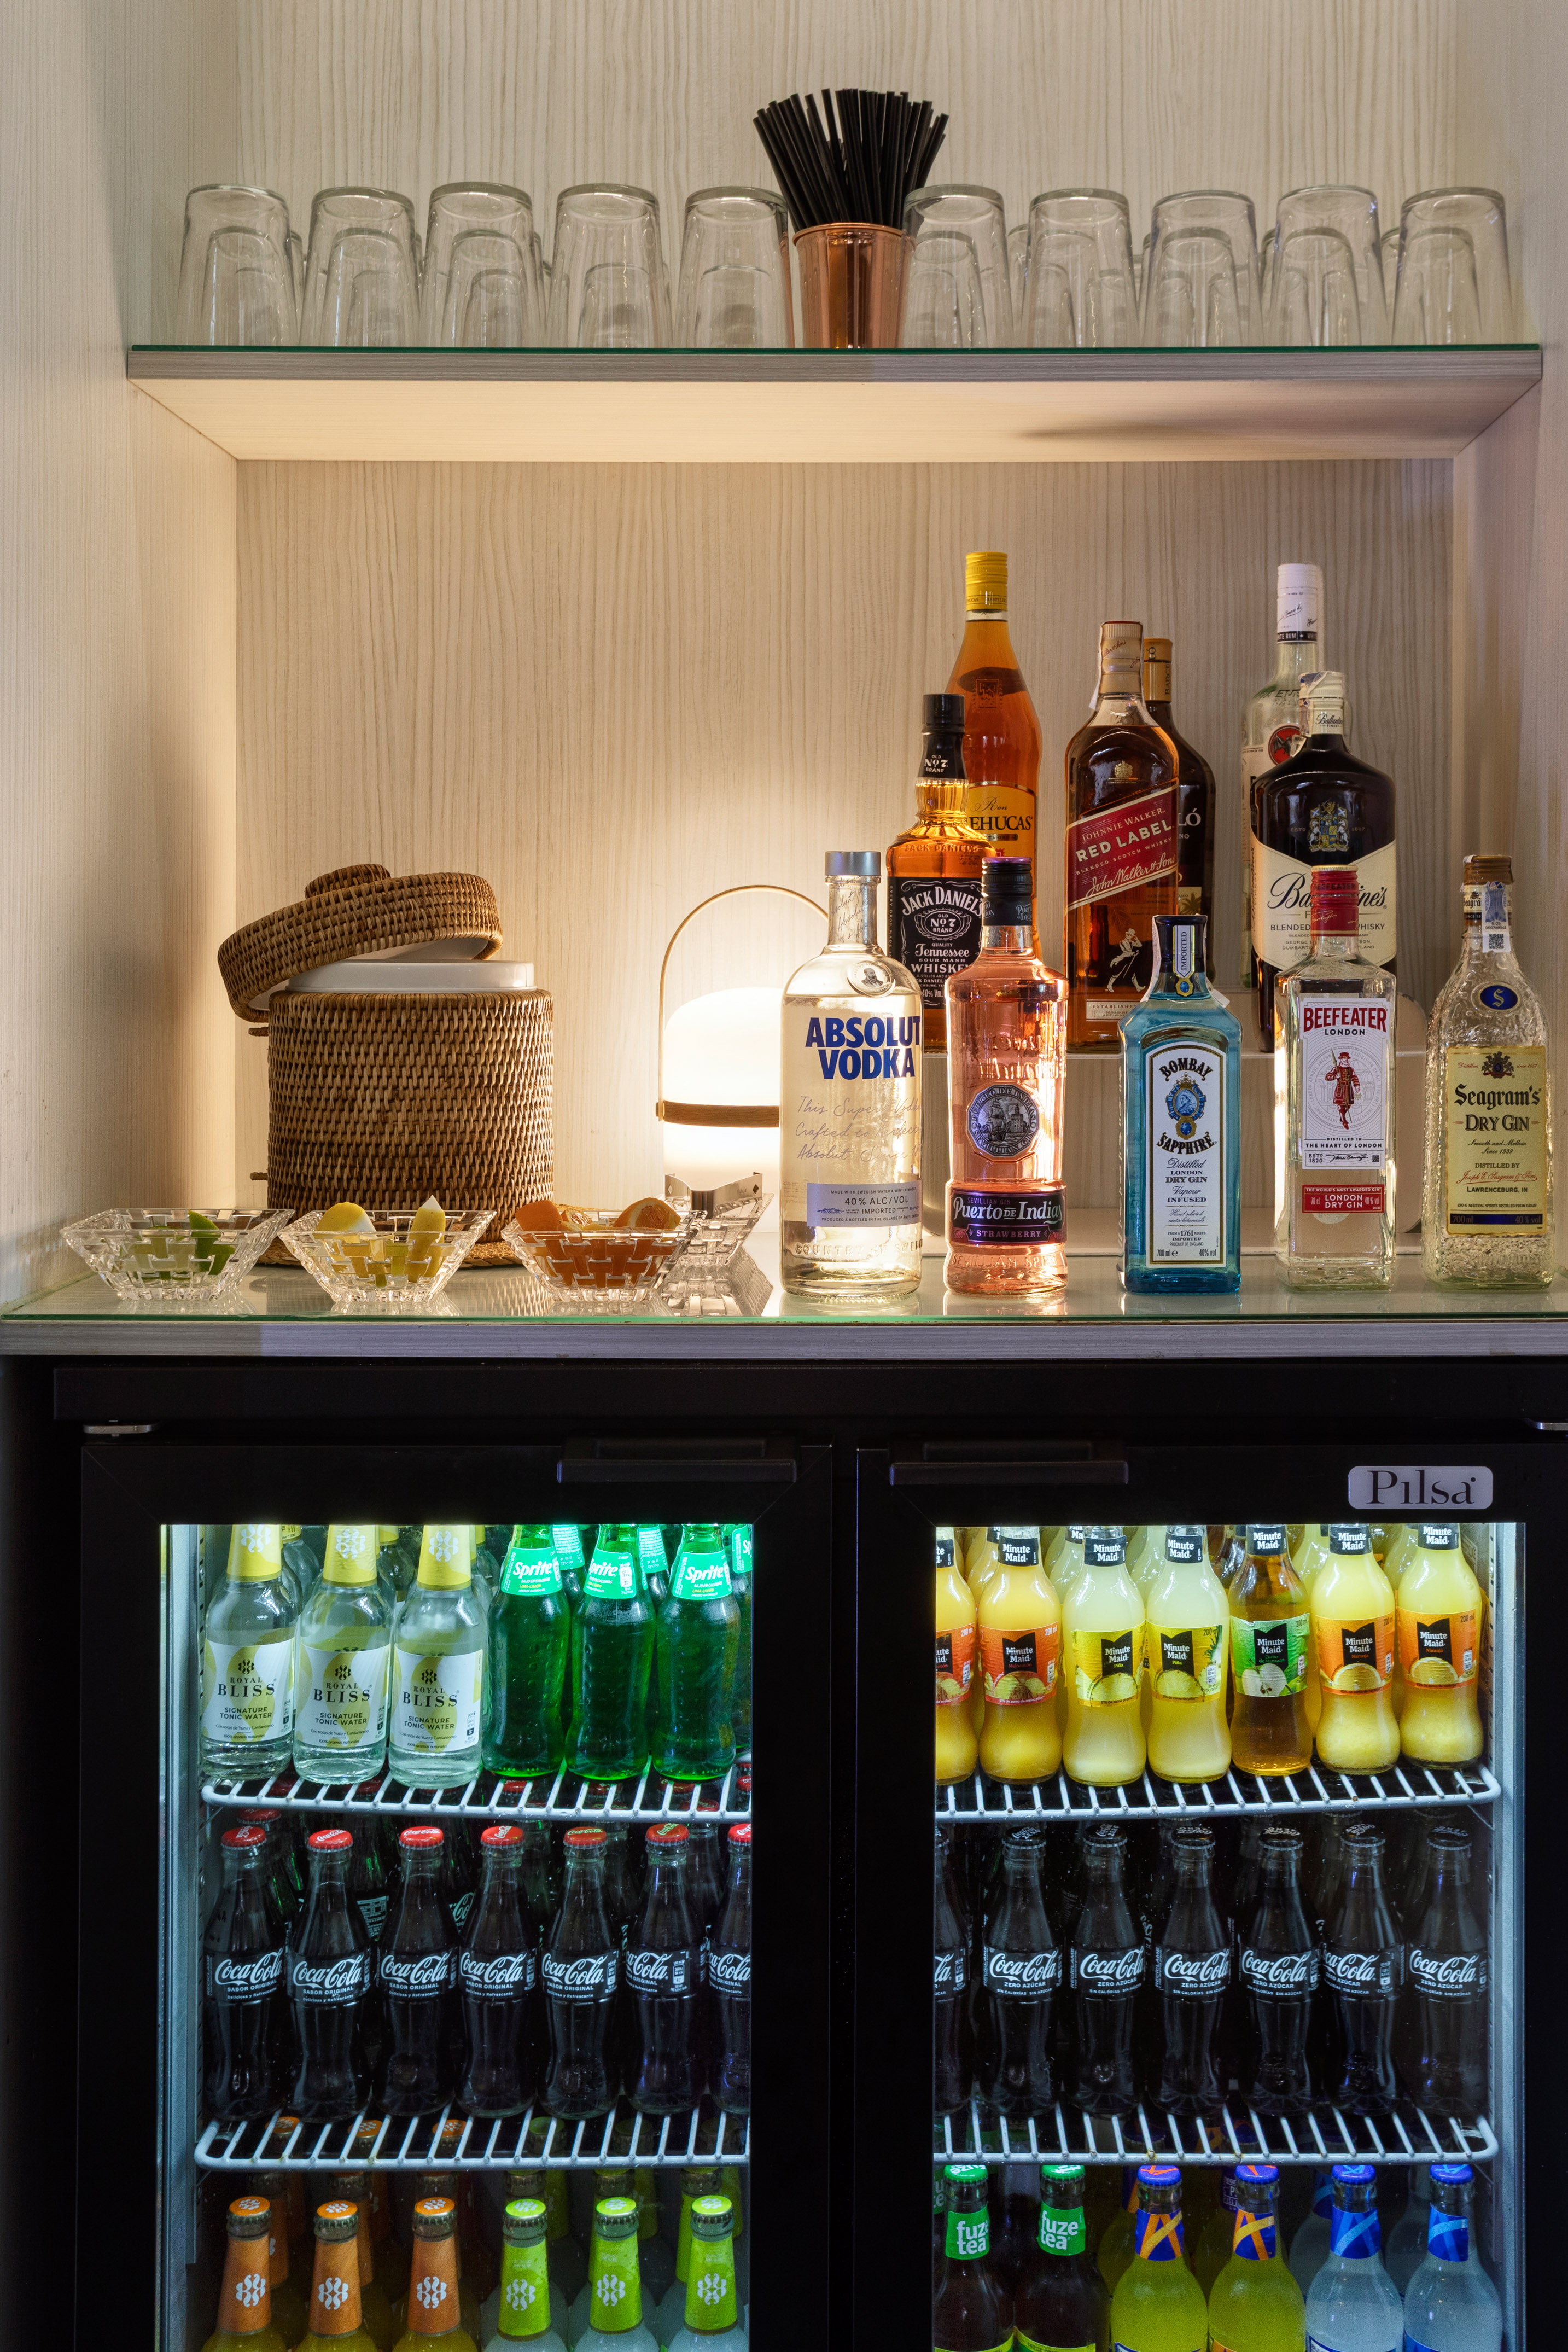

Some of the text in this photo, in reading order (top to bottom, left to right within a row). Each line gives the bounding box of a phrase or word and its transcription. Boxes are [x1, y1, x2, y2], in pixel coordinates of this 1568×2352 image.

[971, 796, 1007, 812] Ron
[967, 816, 1031, 830] EHUCAS
[1081, 822, 1123, 844] JOHNNIE
[1124, 808, 1163, 826] WALKER
[1076, 819, 1171, 863] RED LABEL
[1076, 837, 1172, 875] BLENDED SCOTCH WHISKY
[901, 888, 934, 916] JACK
[934, 886, 984, 916] DANIEL'S
[915, 944, 970, 957] Tennessee
[1303, 1007, 1386, 1033] BEEFEATER
[805, 1015, 921, 1049] ABSOLUT
[818, 1047, 916, 1080] VODKA
[1159, 1057, 1213, 1082] BOMBAY
[1454, 1083, 1540, 1110] Seagram's
[972, 1089, 995, 1121] PUERTO
[1015, 1090, 1036, 1121] INDIAS
[1465, 1114, 1530, 1131] DRY GIN
[974, 1130, 1035, 1156] SEVILLIAN GIN
[1156, 1132, 1215, 1155] SAPPHIRE
[1166, 1158, 1205, 1169] Distilled
[1172, 1186, 1202, 1195] Vapour
[953, 1196, 1063, 1224] Puerto DE Indias
[976, 1230, 1041, 1238] STRAWBERRY
[1253, 1532, 1281, 1541] Minute
[1338, 1532, 1366, 1541] Minute
[1423, 1526, 1452, 1536] Minute
[1168, 1538, 1194, 1550] Minute
[1256, 1540, 1280, 1550] Maid
[1342, 1541, 1365, 1550] Maid
[1426, 1535, 1449, 1545] Maid
[1002, 1543, 1030, 1553] Minute
[1094, 1544, 1121, 1553] Minute
[1169, 1548, 1191, 1559] Maid
[1005, 1553, 1028, 1563] Maid
[1097, 1553, 1119, 1562] Maid
[513, 1561, 552, 1579] Sprite
[685, 1565, 724, 1583] Sprite
[1345, 1637, 1373, 1646] Minute
[1420, 1631, 1448, 1640] Minute
[1163, 1643, 1190, 1652] Minute
[1349, 1644, 1371, 1653] Maid
[1424, 1639, 1445, 1647] Maid
[1005, 1647, 1033, 1655] Minute
[1105, 1646, 1131, 1656] Minute
[1167, 1651, 1187, 1660] Maid
[1261, 1645, 1283, 1654] Maid
[1010, 1655, 1031, 1663] Maid
[1109, 1655, 1129, 1663] Maid
[218, 1683, 275, 1697] BLISS
[313, 1689, 370, 1703] BLISS
[403, 1691, 457, 1708] BLISS
[404, 1721, 425, 1729] TONIC
[317, 1829, 345, 1841] Coca-Cola
[215, 1947, 283, 1987] Coca-Cola
[381, 1950, 451, 1984] Coca-Cola
[460, 1952, 527, 1983] Coca-Cola
[989, 1949, 1059, 1982] Coca-Cola
[1080, 1945, 1144, 1980] Coca-Cola
[1164, 1948, 1230, 1982] Coca-Cola
[1241, 1949, 1310, 1982] Coca-Cola
[1409, 1949, 1479, 1983] Coca-Cola
[293, 1953, 364, 1988] Coca-Cola
[542, 1953, 608, 1985] Coca-Cola
[250, 1980, 277, 1990] ORIGINAL
[465, 1980, 482, 1988] SABOR
[547, 1981, 563, 1990] SABOR
[633, 1976, 658, 1986] ORIGINAL
[1022, 1980, 1046, 1988] AZÚCAR
[1116, 1977, 1137, 1987] AZÚCAR
[1252, 1979, 1267, 1987] ZERO
[1337, 1977, 1361, 1987] AZÚCAR
[1420, 1978, 1436, 1987] ZERO
[1041, 2209, 1079, 2235] fuze
[957, 2220, 989, 2240] fuze
[1041, 2229, 1068, 2250] tea
[957, 2237, 987, 2255] tea
